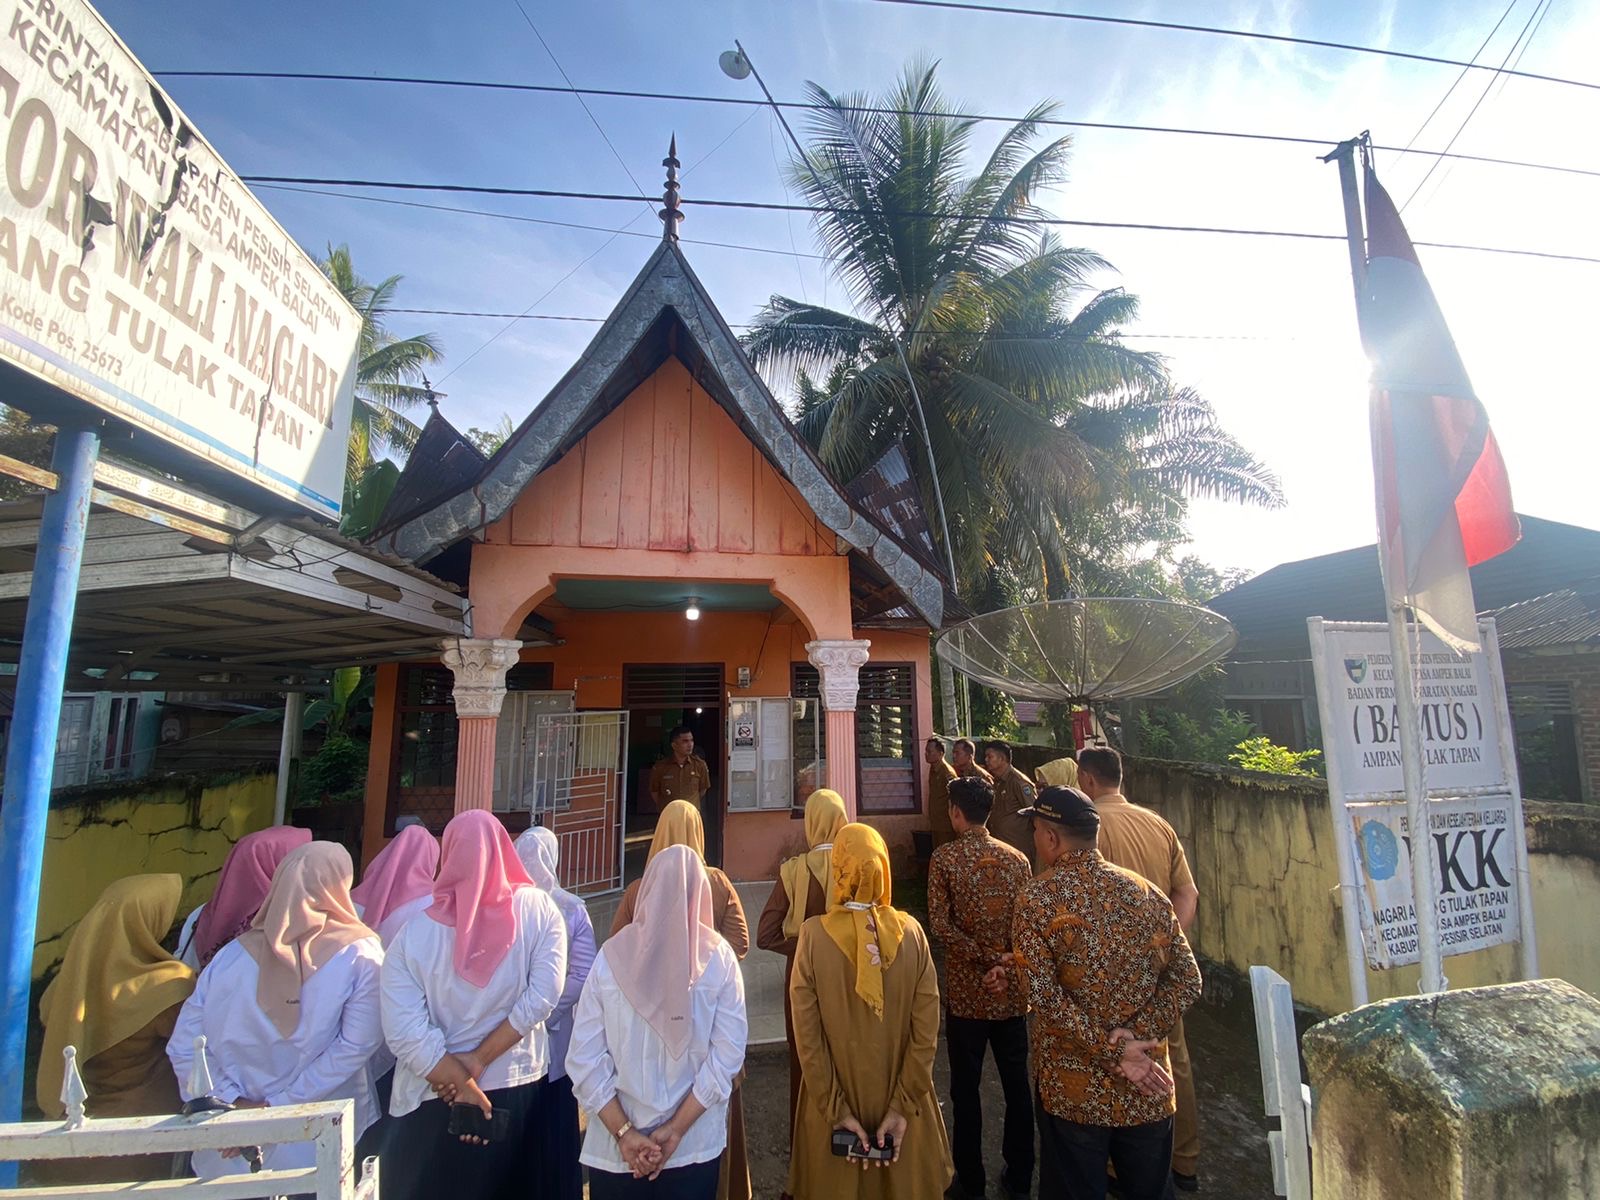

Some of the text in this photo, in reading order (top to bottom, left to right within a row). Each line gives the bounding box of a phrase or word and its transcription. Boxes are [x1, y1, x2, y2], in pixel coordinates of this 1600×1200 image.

[8, 8, 319, 334] KECAMATAN BASA AMPEK BALAI
[243, 215, 292, 281] PESISIR
[294, 270, 341, 331] SELATAN
[0, 292, 123, 377] Kode Pos. 25673
[223, 282, 338, 431] NAGARI
[105, 289, 220, 399] TULAK
[227, 373, 304, 451] TAPAN
[1347, 687, 1375, 700] BADAN
[1450, 684, 1478, 697] NAGARI
[1363, 750, 1402, 768] AMPAN
[1449, 746, 1481, 763] TAPAN
[1373, 903, 1408, 926] NAGARI
[1447, 894, 1478, 913] TULAK
[1479, 890, 1509, 908] TAPAN
[1454, 912, 1481, 928] AMPEK
[1482, 908, 1506, 922] BALAI
[1469, 922, 1503, 940] SELATAN
